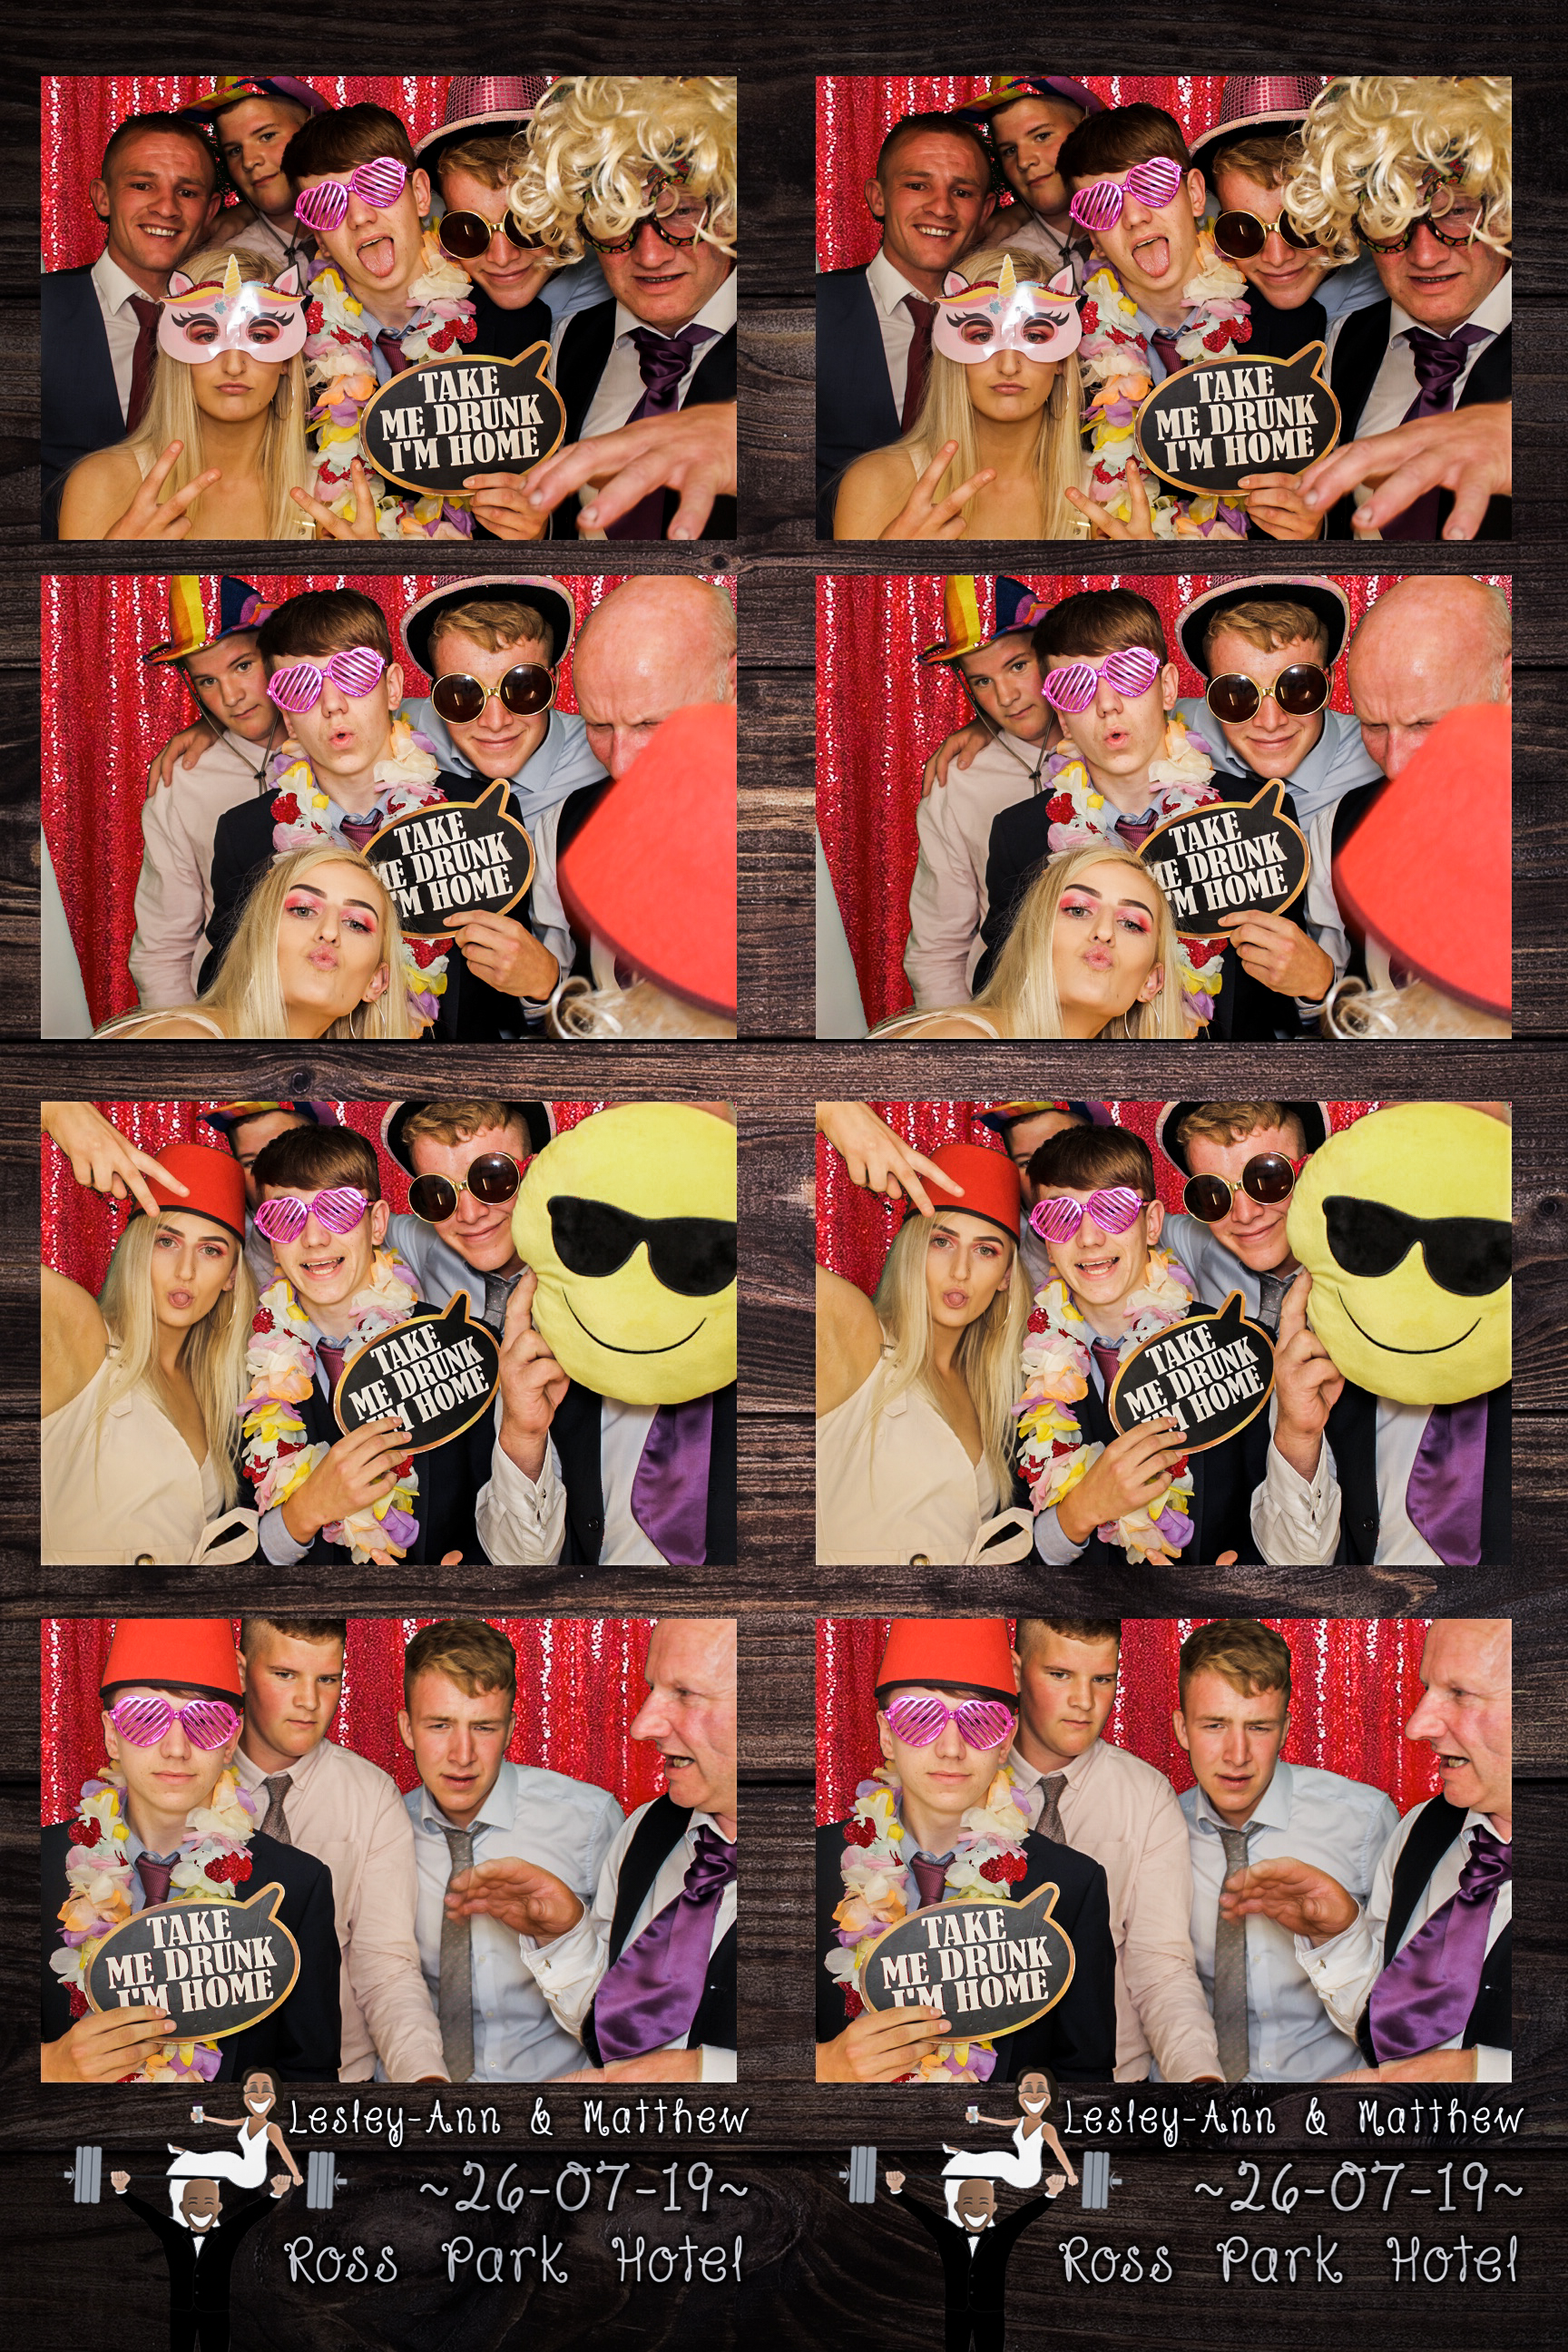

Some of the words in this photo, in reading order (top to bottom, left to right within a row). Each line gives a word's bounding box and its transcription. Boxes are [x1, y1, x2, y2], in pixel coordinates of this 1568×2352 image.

[418, 366, 500, 404] TAKE
[1193, 366, 1275, 404] TAKE
[379, 406, 426, 441] ME
[433, 394, 544, 436] DRUNK
[1154, 406, 1200, 441] ME
[1208, 394, 1319, 436] DRUNK
[389, 437, 440, 473] I'M
[448, 426, 540, 466] HOME
[1164, 437, 1215, 473] I'M
[1223, 426, 1315, 466] HOME
[393, 810, 467, 856] TAKE
[410, 831, 514, 884] DRUNK
[1168, 810, 1242, 856] TAKE
[1185, 831, 1289, 884] DRUNK
[389, 885, 425, 918] 'M
[426, 864, 514, 912] HOME
[1164, 885, 1200, 918] 'M
[1201, 864, 1289, 912] HOME
[369, 1323, 442, 1376] TAKE
[1144, 1323, 1217, 1376] TAKE
[348, 1379, 393, 1422] ME
[391, 1336, 485, 1400] DRUNK
[366, 1402, 416, 1433] 'M
[412, 1365, 490, 1424] HOME
[1122, 1379, 1168, 1422] ME
[1166, 1336, 1259, 1400] DRUNK
[1141, 1402, 1191, 1433] 'M
[1187, 1365, 1265, 1424] HOME
[145, 1908, 232, 1949] TAKE
[920, 1908, 1007, 1949] TAKE
[105, 1952, 156, 1990] ME
[163, 1936, 278, 1982] DRUNK
[880, 1952, 931, 1990] ME
[938, 1936, 1053, 1982] DRUNK
[179, 1968, 275, 2014] HOME
[954, 1968, 1050, 2014] HOME
